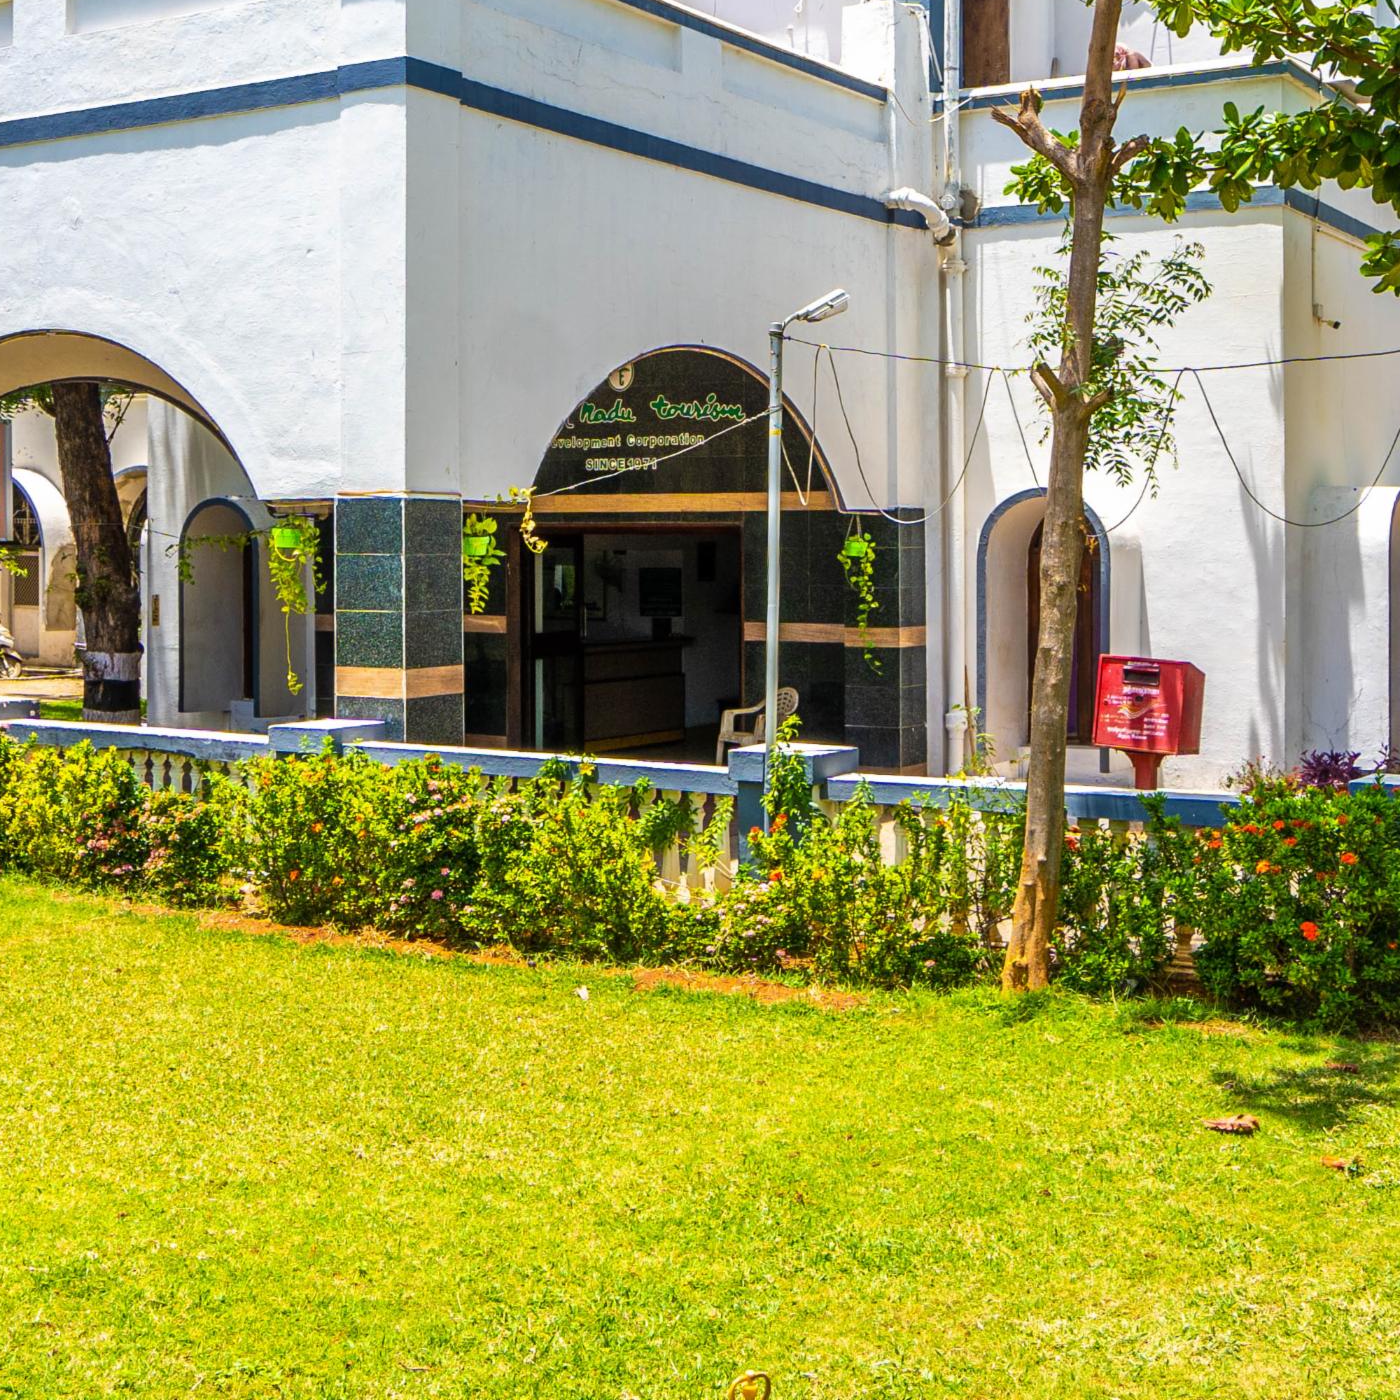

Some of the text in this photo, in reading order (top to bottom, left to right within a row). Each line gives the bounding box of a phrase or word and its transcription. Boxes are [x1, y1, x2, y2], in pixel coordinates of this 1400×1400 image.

[650, 393, 746, 422] tourism
[626, 432, 705, 449] Corporation
[585, 457, 658, 471] SINCE 1971
